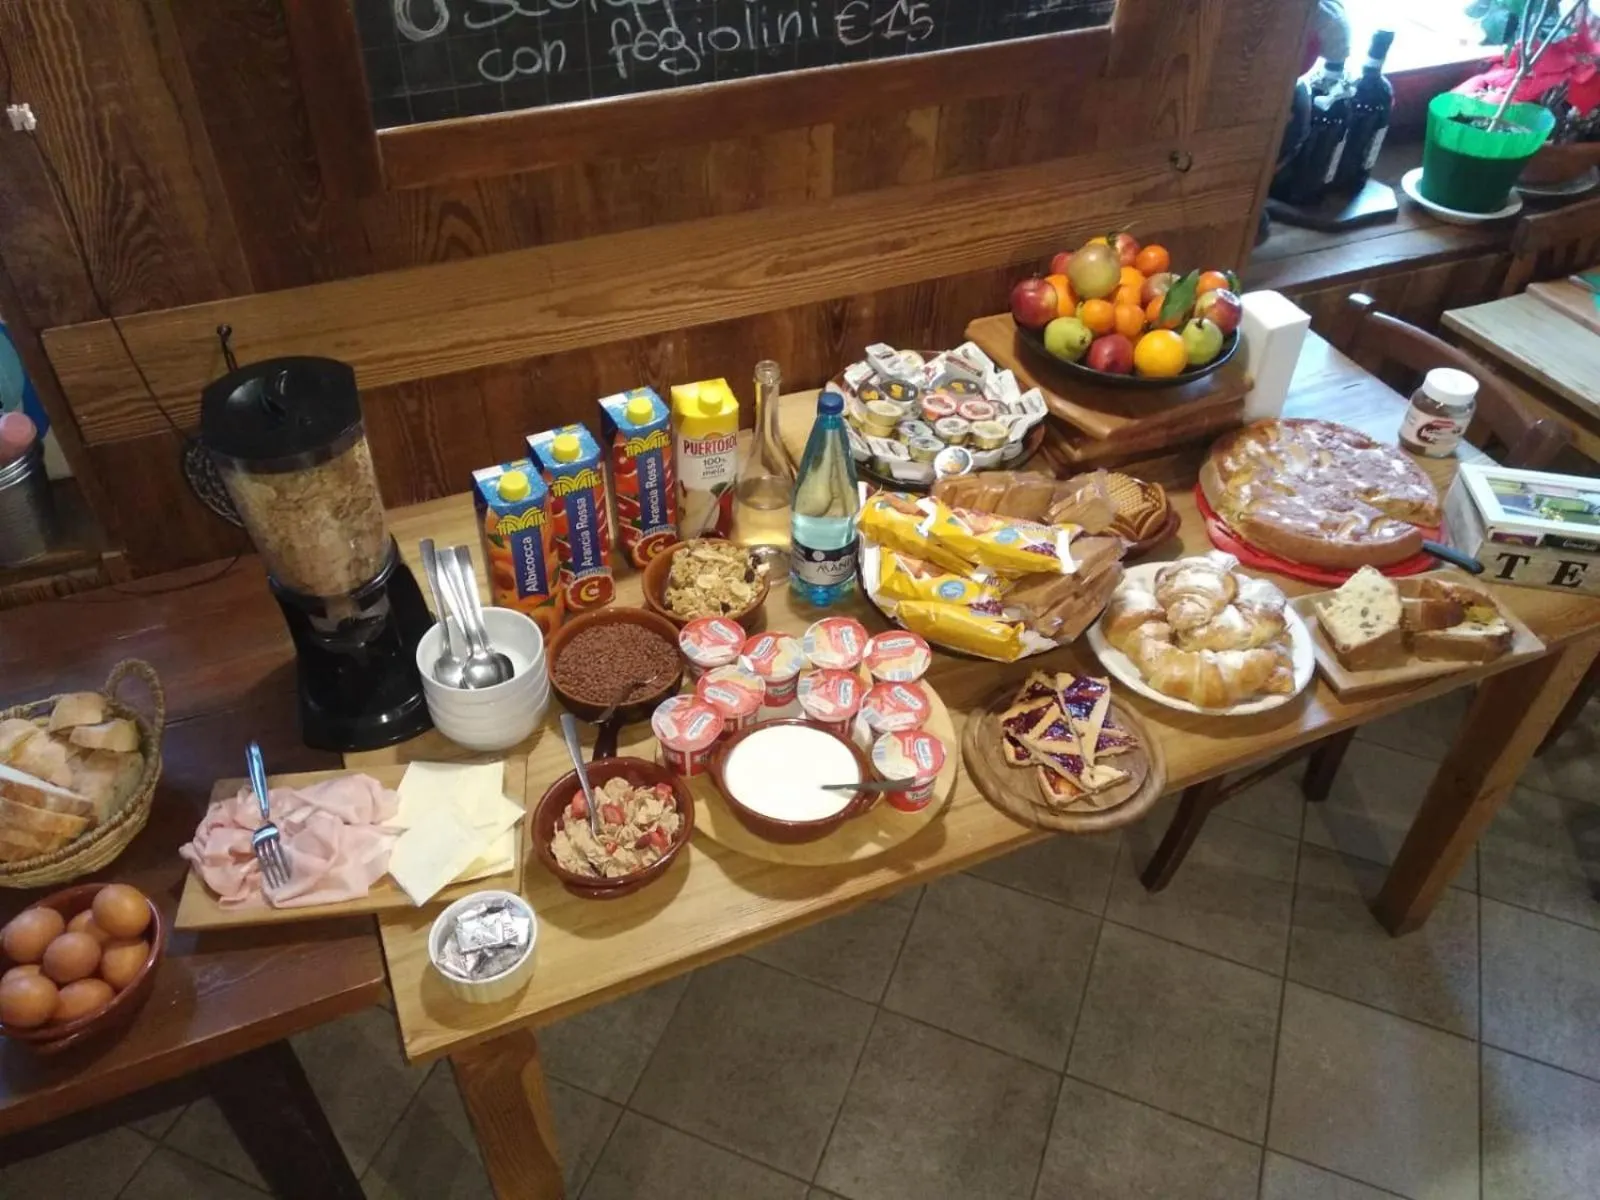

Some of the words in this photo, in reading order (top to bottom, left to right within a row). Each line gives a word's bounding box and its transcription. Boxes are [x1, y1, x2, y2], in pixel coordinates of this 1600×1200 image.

[477, 39, 567, 82] con
[645, 457, 656, 492] Rossa
[576, 497, 588, 530] Rossa
[648, 493, 660, 524] Arancia
[526, 535, 539, 593] Albicocca
[581, 529, 593, 567] Arancia
